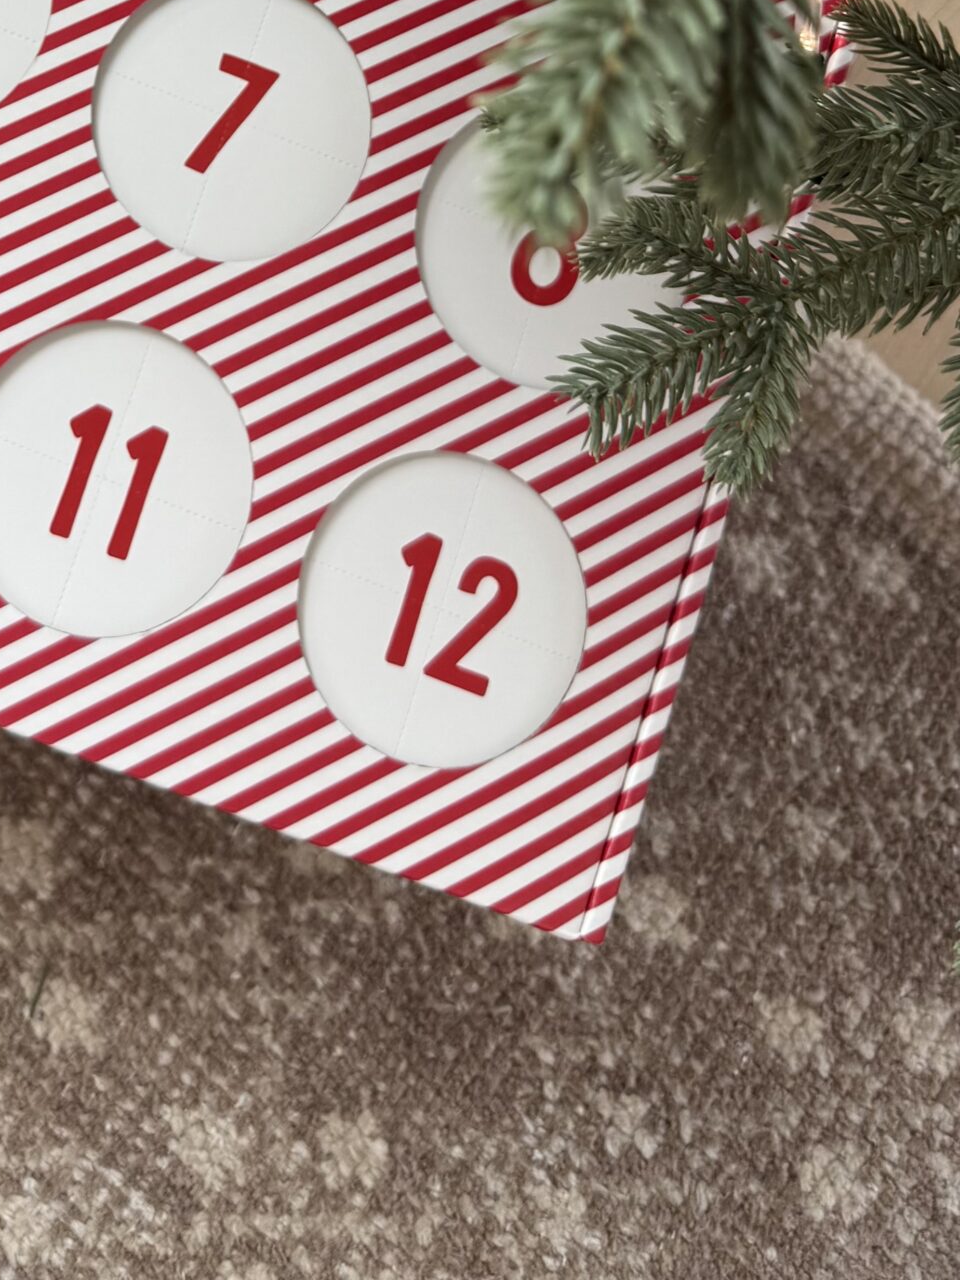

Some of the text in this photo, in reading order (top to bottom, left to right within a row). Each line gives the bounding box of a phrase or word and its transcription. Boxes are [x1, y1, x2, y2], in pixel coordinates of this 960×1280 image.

[185, 54, 280, 174] 7
[50, 405, 175, 561] 11
[385, 533, 519, 697] 12
